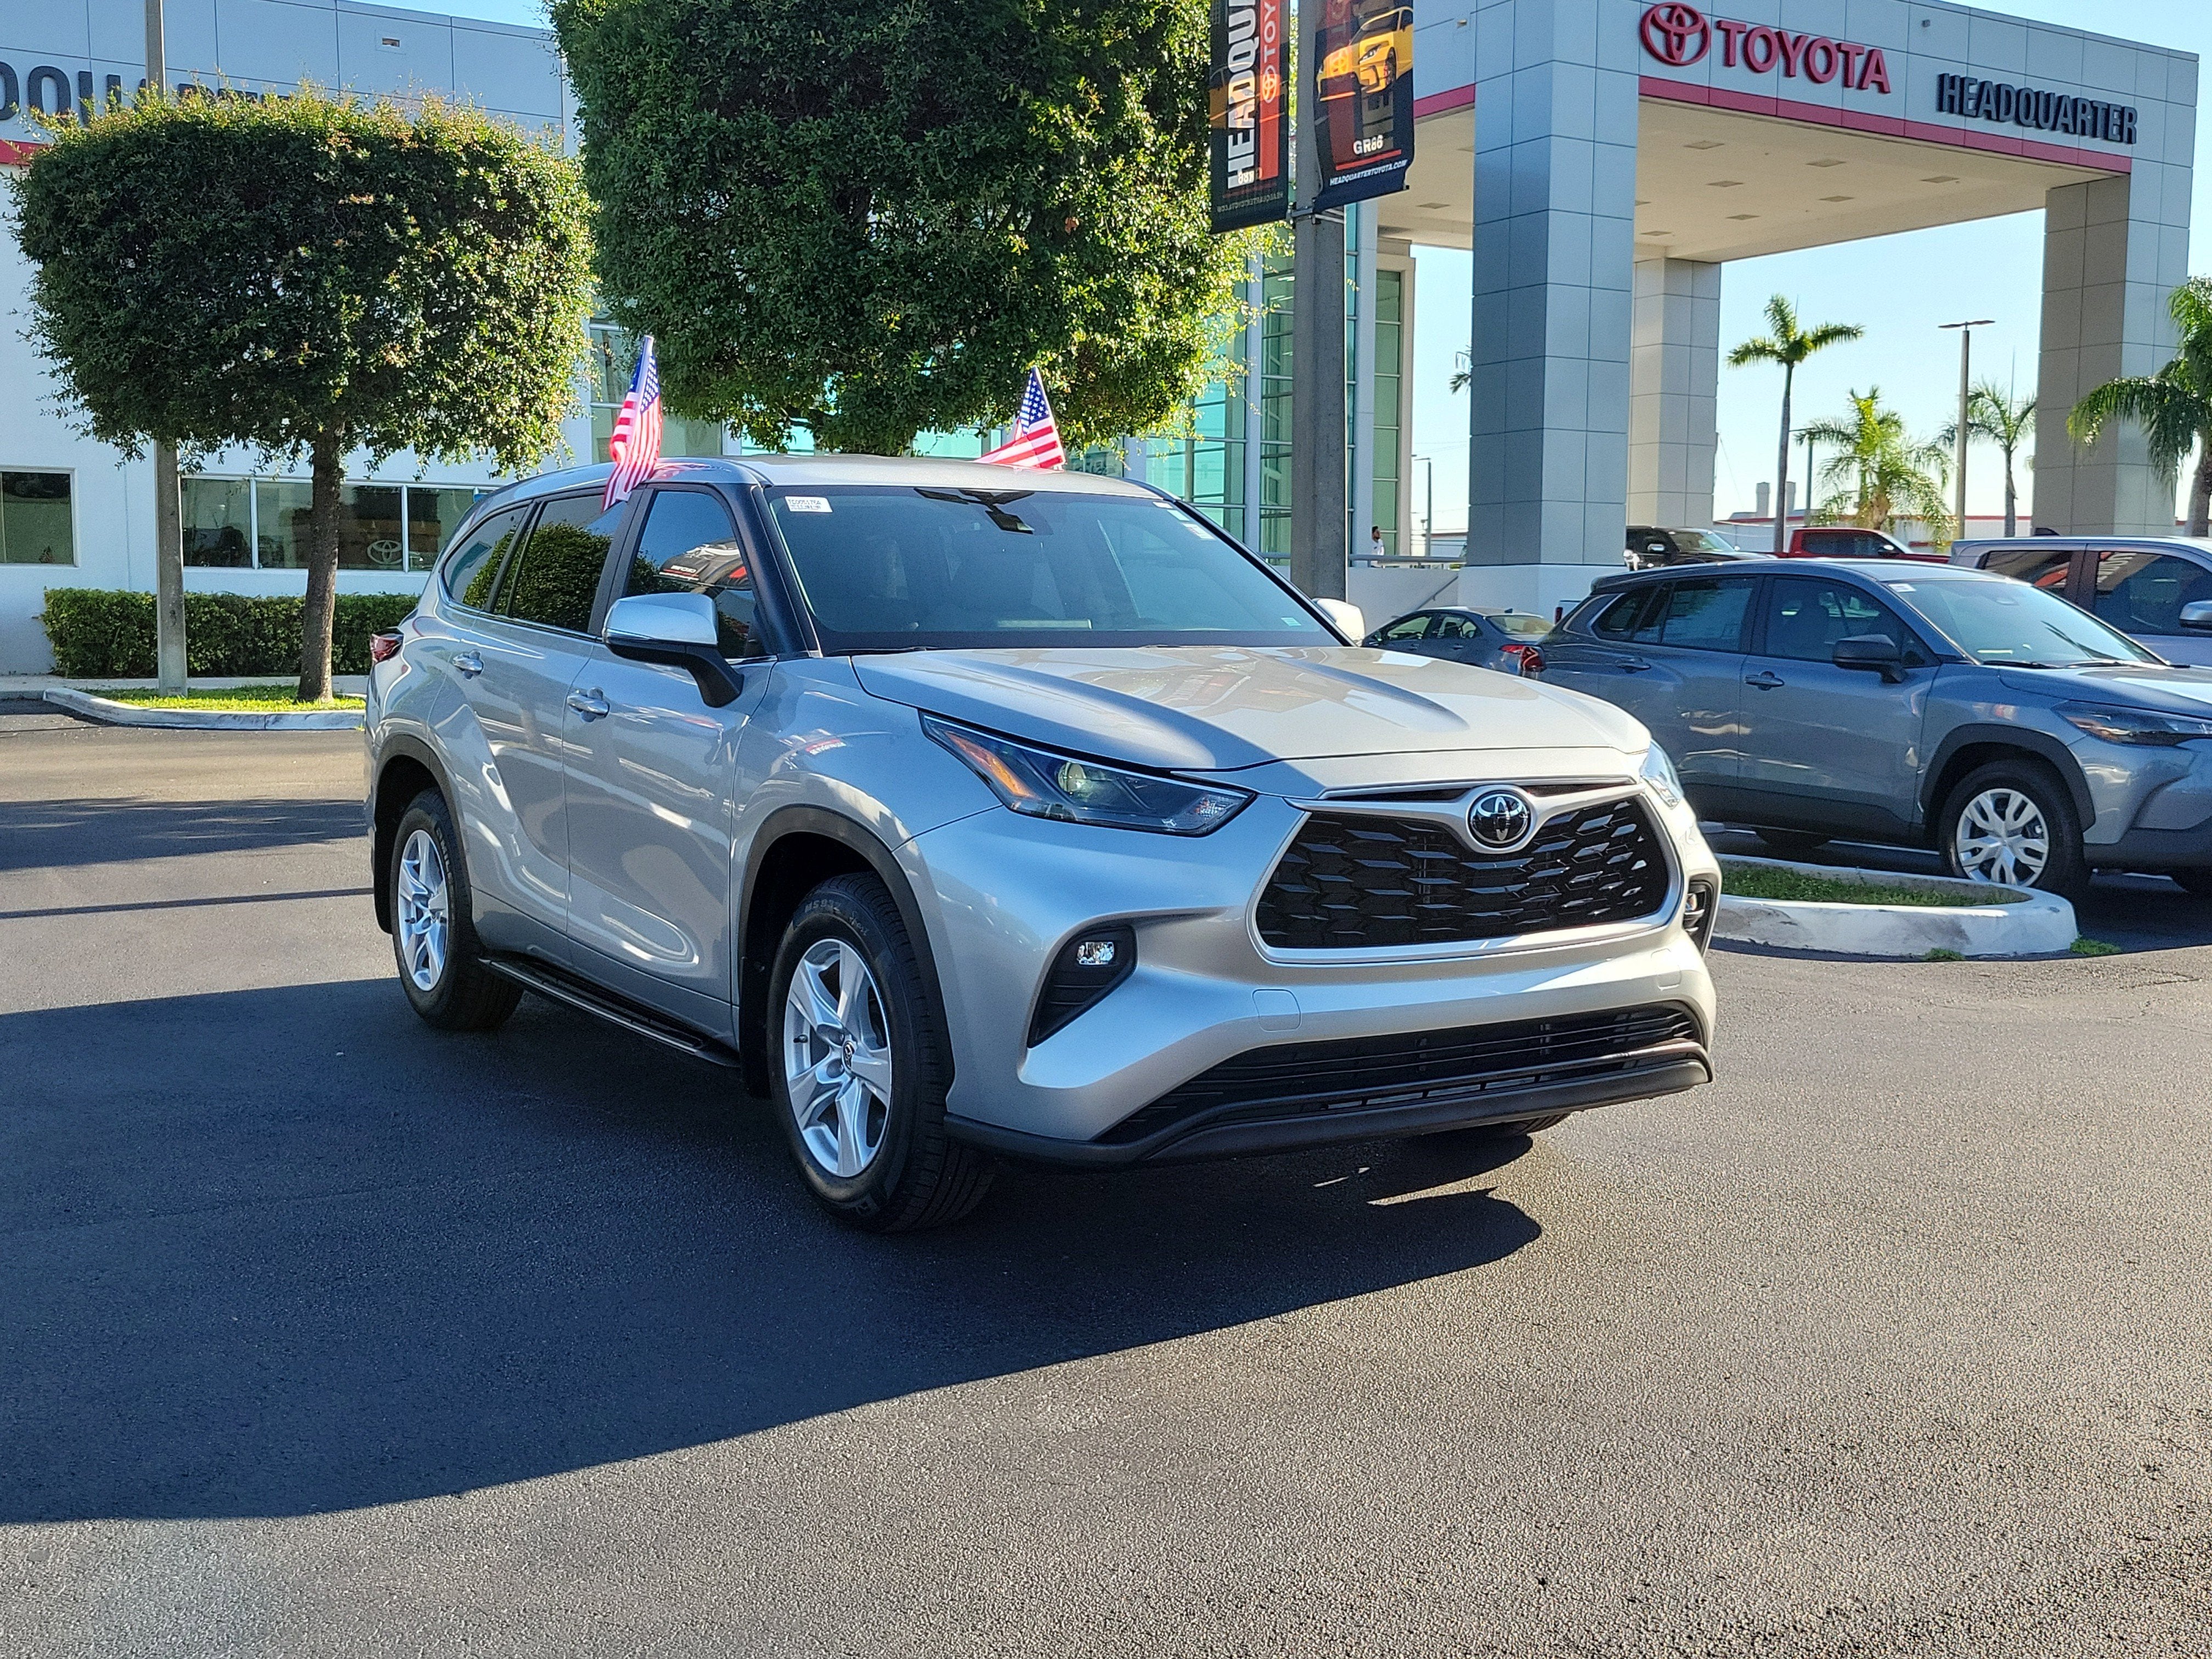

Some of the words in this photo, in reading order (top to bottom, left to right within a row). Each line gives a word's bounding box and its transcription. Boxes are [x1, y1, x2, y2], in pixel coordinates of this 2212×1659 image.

[1717, 20, 1891, 94] TOYOTA
[1228, 0, 1259, 189] HEADQU
[1936, 72, 2137, 144] HEADQUARTER
[1329, 159, 1408, 186] HEADQUARTERTOYOTA.COM
